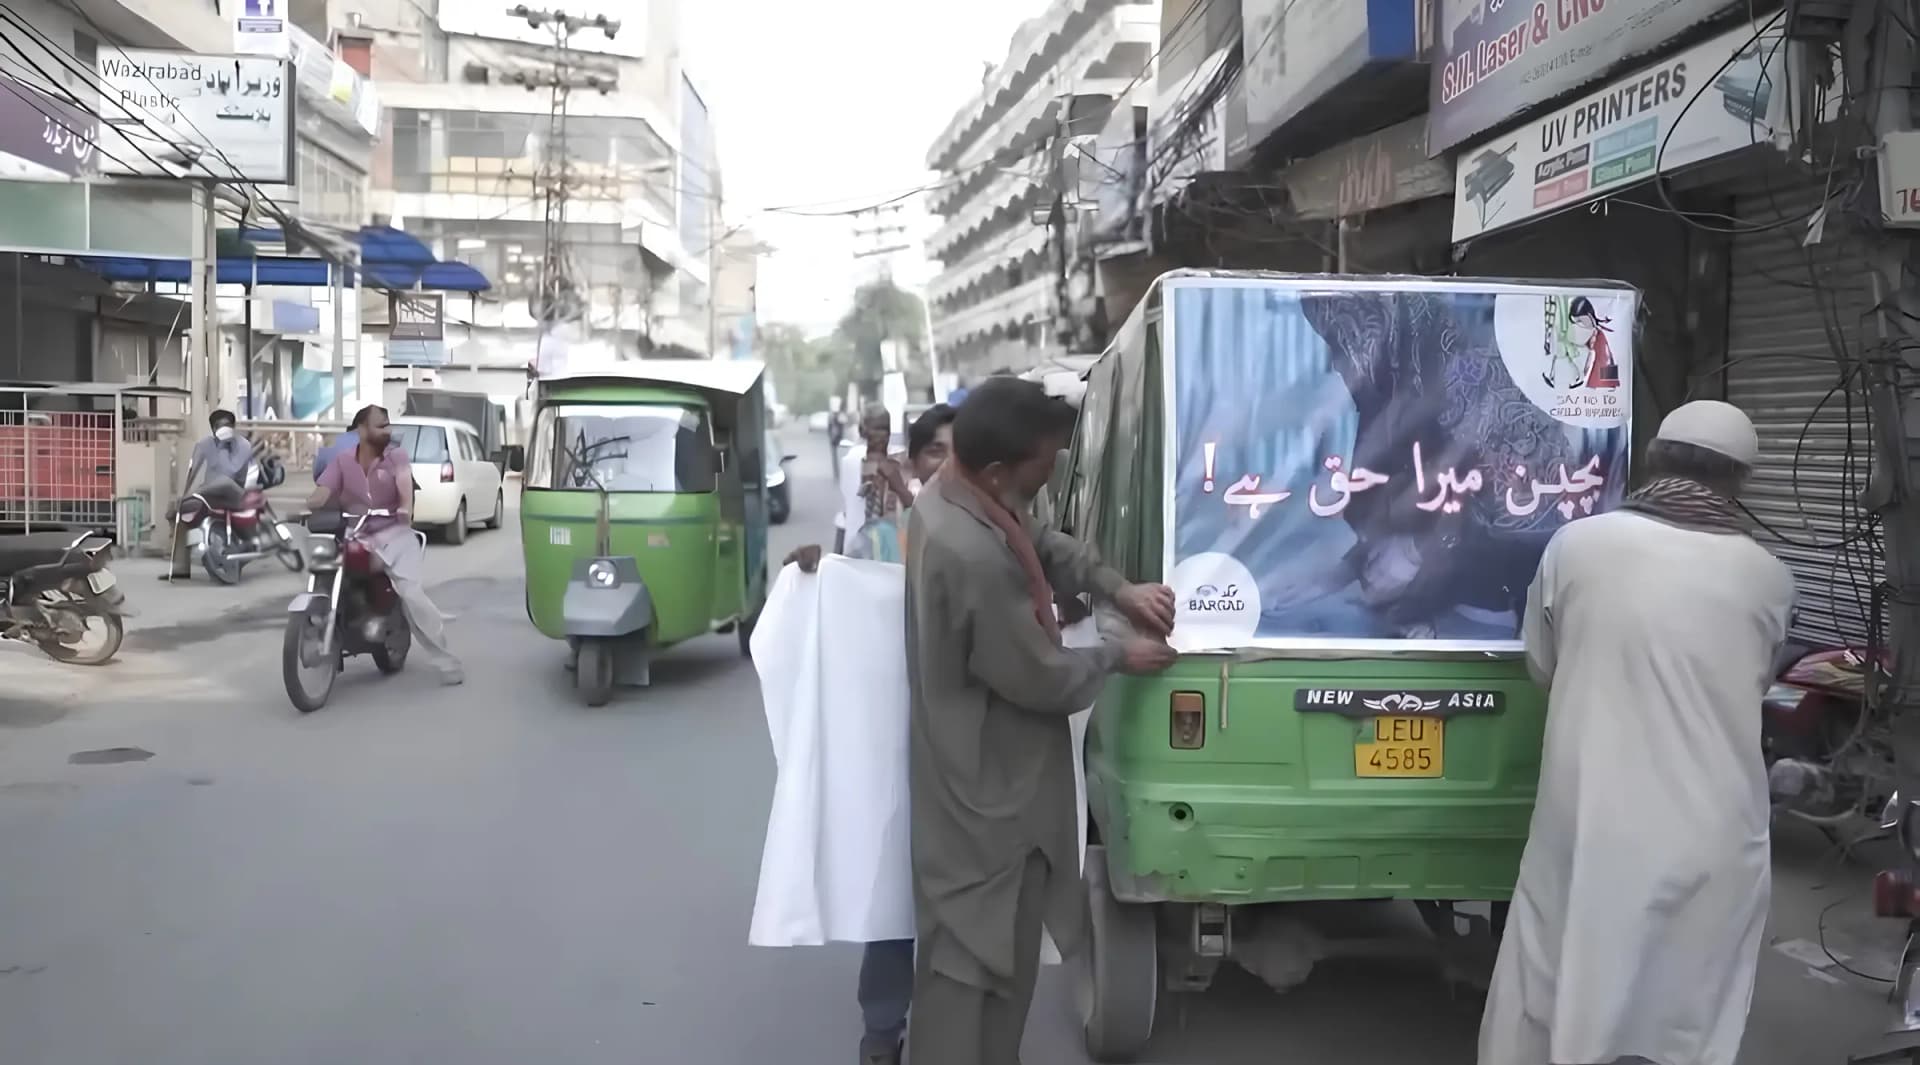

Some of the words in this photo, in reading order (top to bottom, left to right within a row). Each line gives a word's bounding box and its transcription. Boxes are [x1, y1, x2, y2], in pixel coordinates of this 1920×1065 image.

[1477, 40, 1528, 82] Laser
[1531, 2, 1549, 46] &
[1542, 114, 1568, 152] UV
[1573, 61, 1687, 139] PRINTERS
[1309, 455, 1390, 517] حق
[1412, 440, 1483, 514] میرا
[1505, 453, 1604, 520] بچپن
[1188, 599, 1245, 612] BARGAD
[1306, 689, 1354, 705] NEW
[1447, 692, 1495, 708] ASIA
[1369, 747, 1431, 770] 4585
[1376, 718, 1424, 742] LEU
